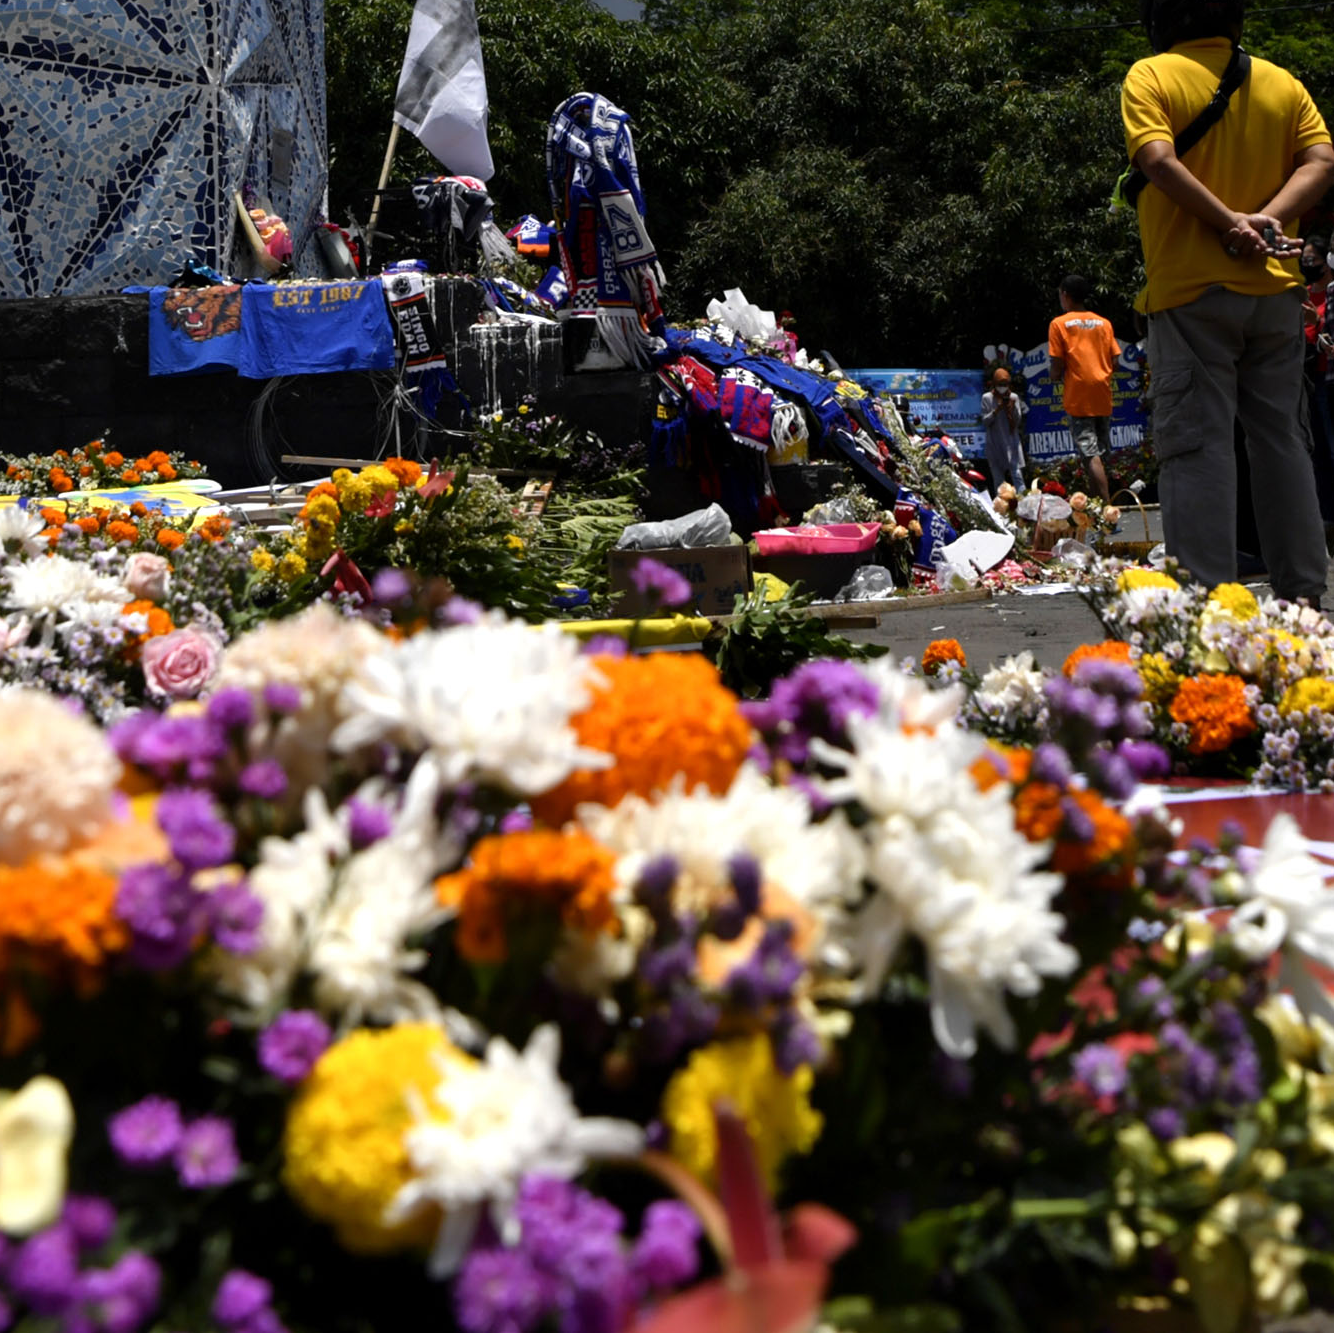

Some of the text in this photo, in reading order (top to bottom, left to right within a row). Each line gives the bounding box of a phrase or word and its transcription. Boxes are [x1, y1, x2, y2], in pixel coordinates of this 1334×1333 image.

[272, 285, 365, 308] EST 1987
[397, 310, 420, 355] EDAN
[408, 305, 430, 353] SINGO
